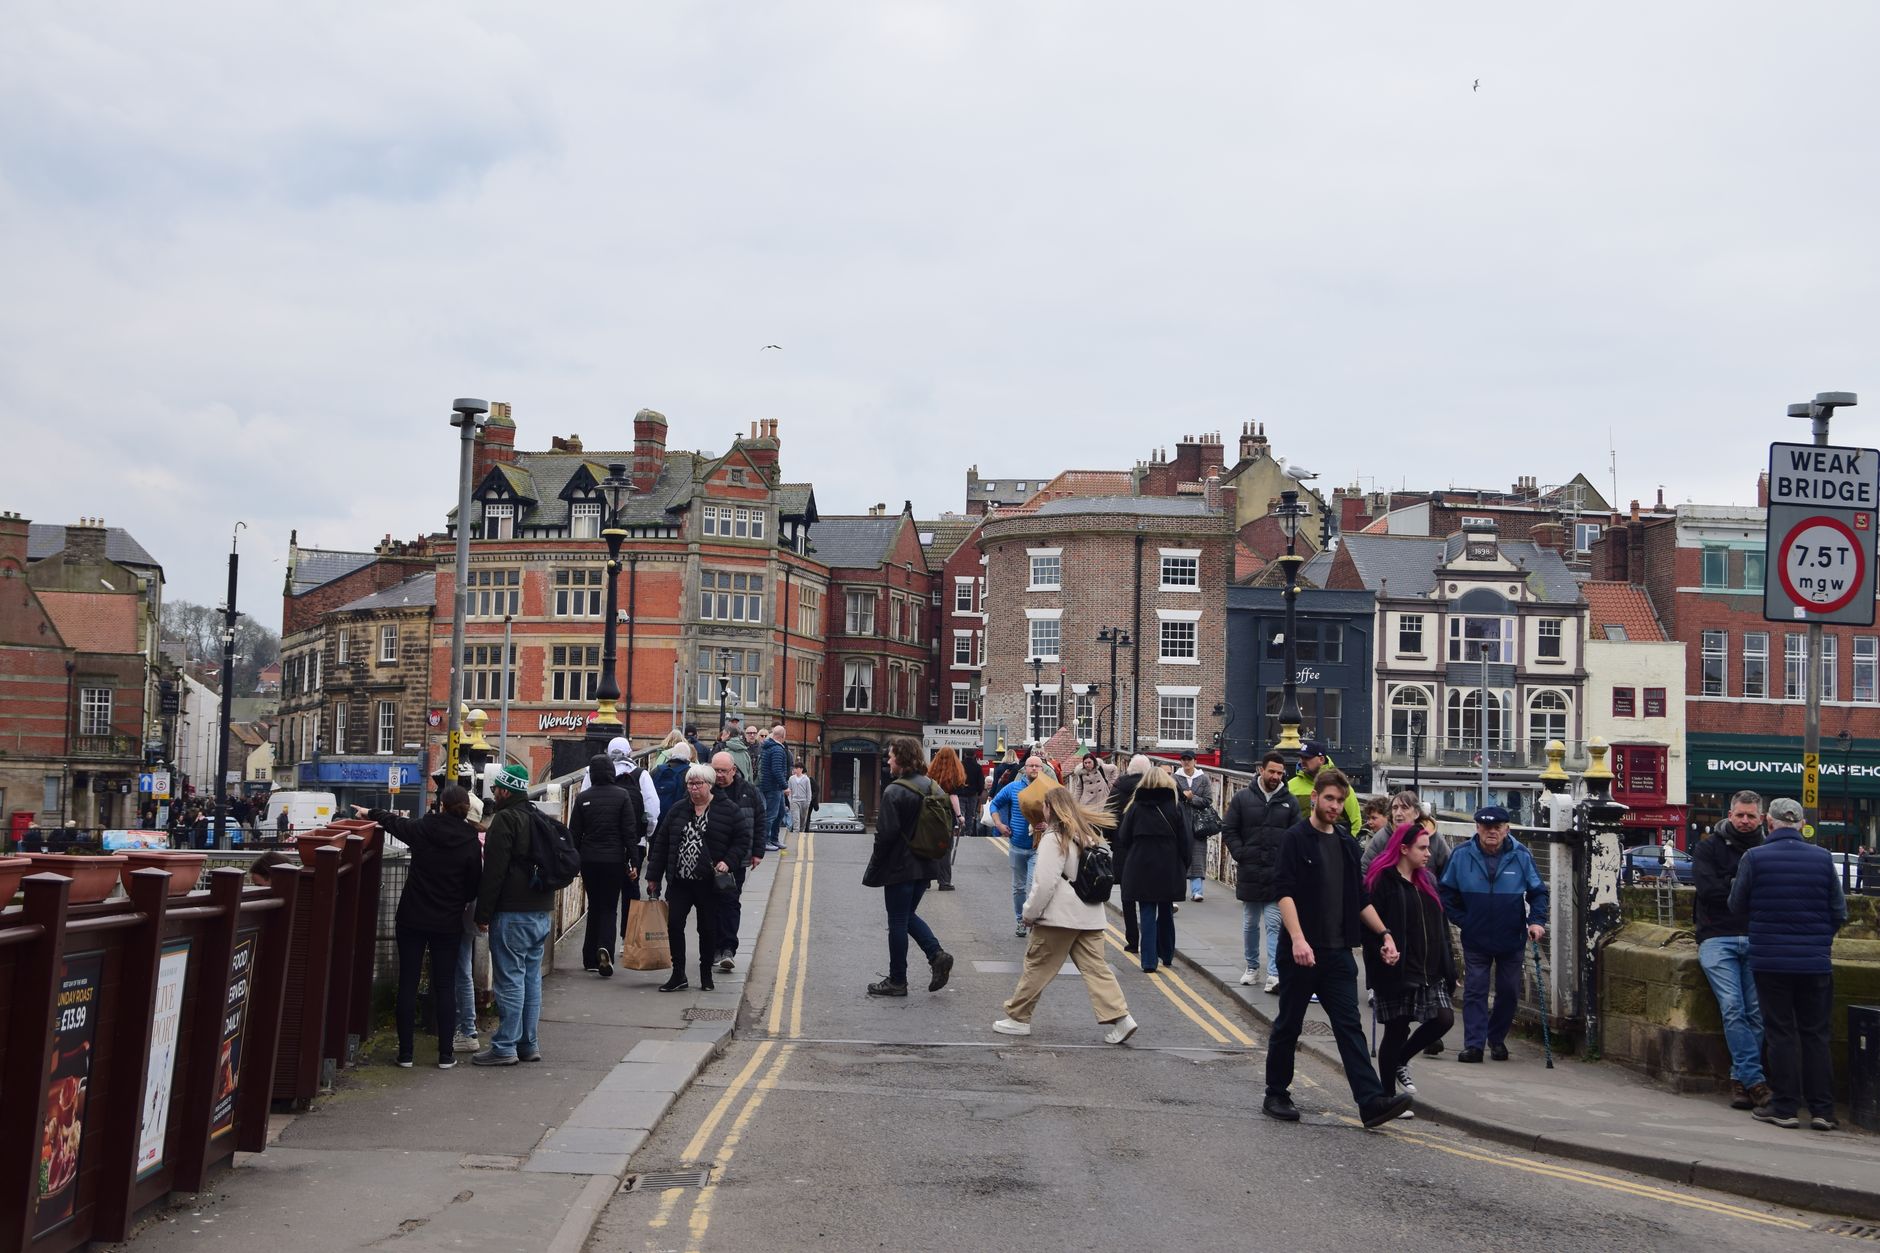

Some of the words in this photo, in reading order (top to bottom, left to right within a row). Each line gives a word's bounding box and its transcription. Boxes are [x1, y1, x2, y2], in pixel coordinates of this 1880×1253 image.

[1790, 450, 1861, 475] WEAK
[1778, 477, 1870, 502] BRIDGE
[1474, 548, 1490, 556] 1898
[1295, 667, 1320, 684] offee
[538, 710, 584, 730] Wendy's
[1616, 754, 1624, 788] ROCK
[1719, 760, 1805, 774] MOUNTAIN
[232, 949, 248, 971] FOOD
[57, 990, 77, 1007] UNDAY
[76, 987, 94, 1004] ROAST
[228, 979, 247, 1003] ERVED
[61, 1005, 87, 1031] £13.99
[224, 1010, 241, 1035] DAILY
[151, 1014, 177, 1048] PORT
